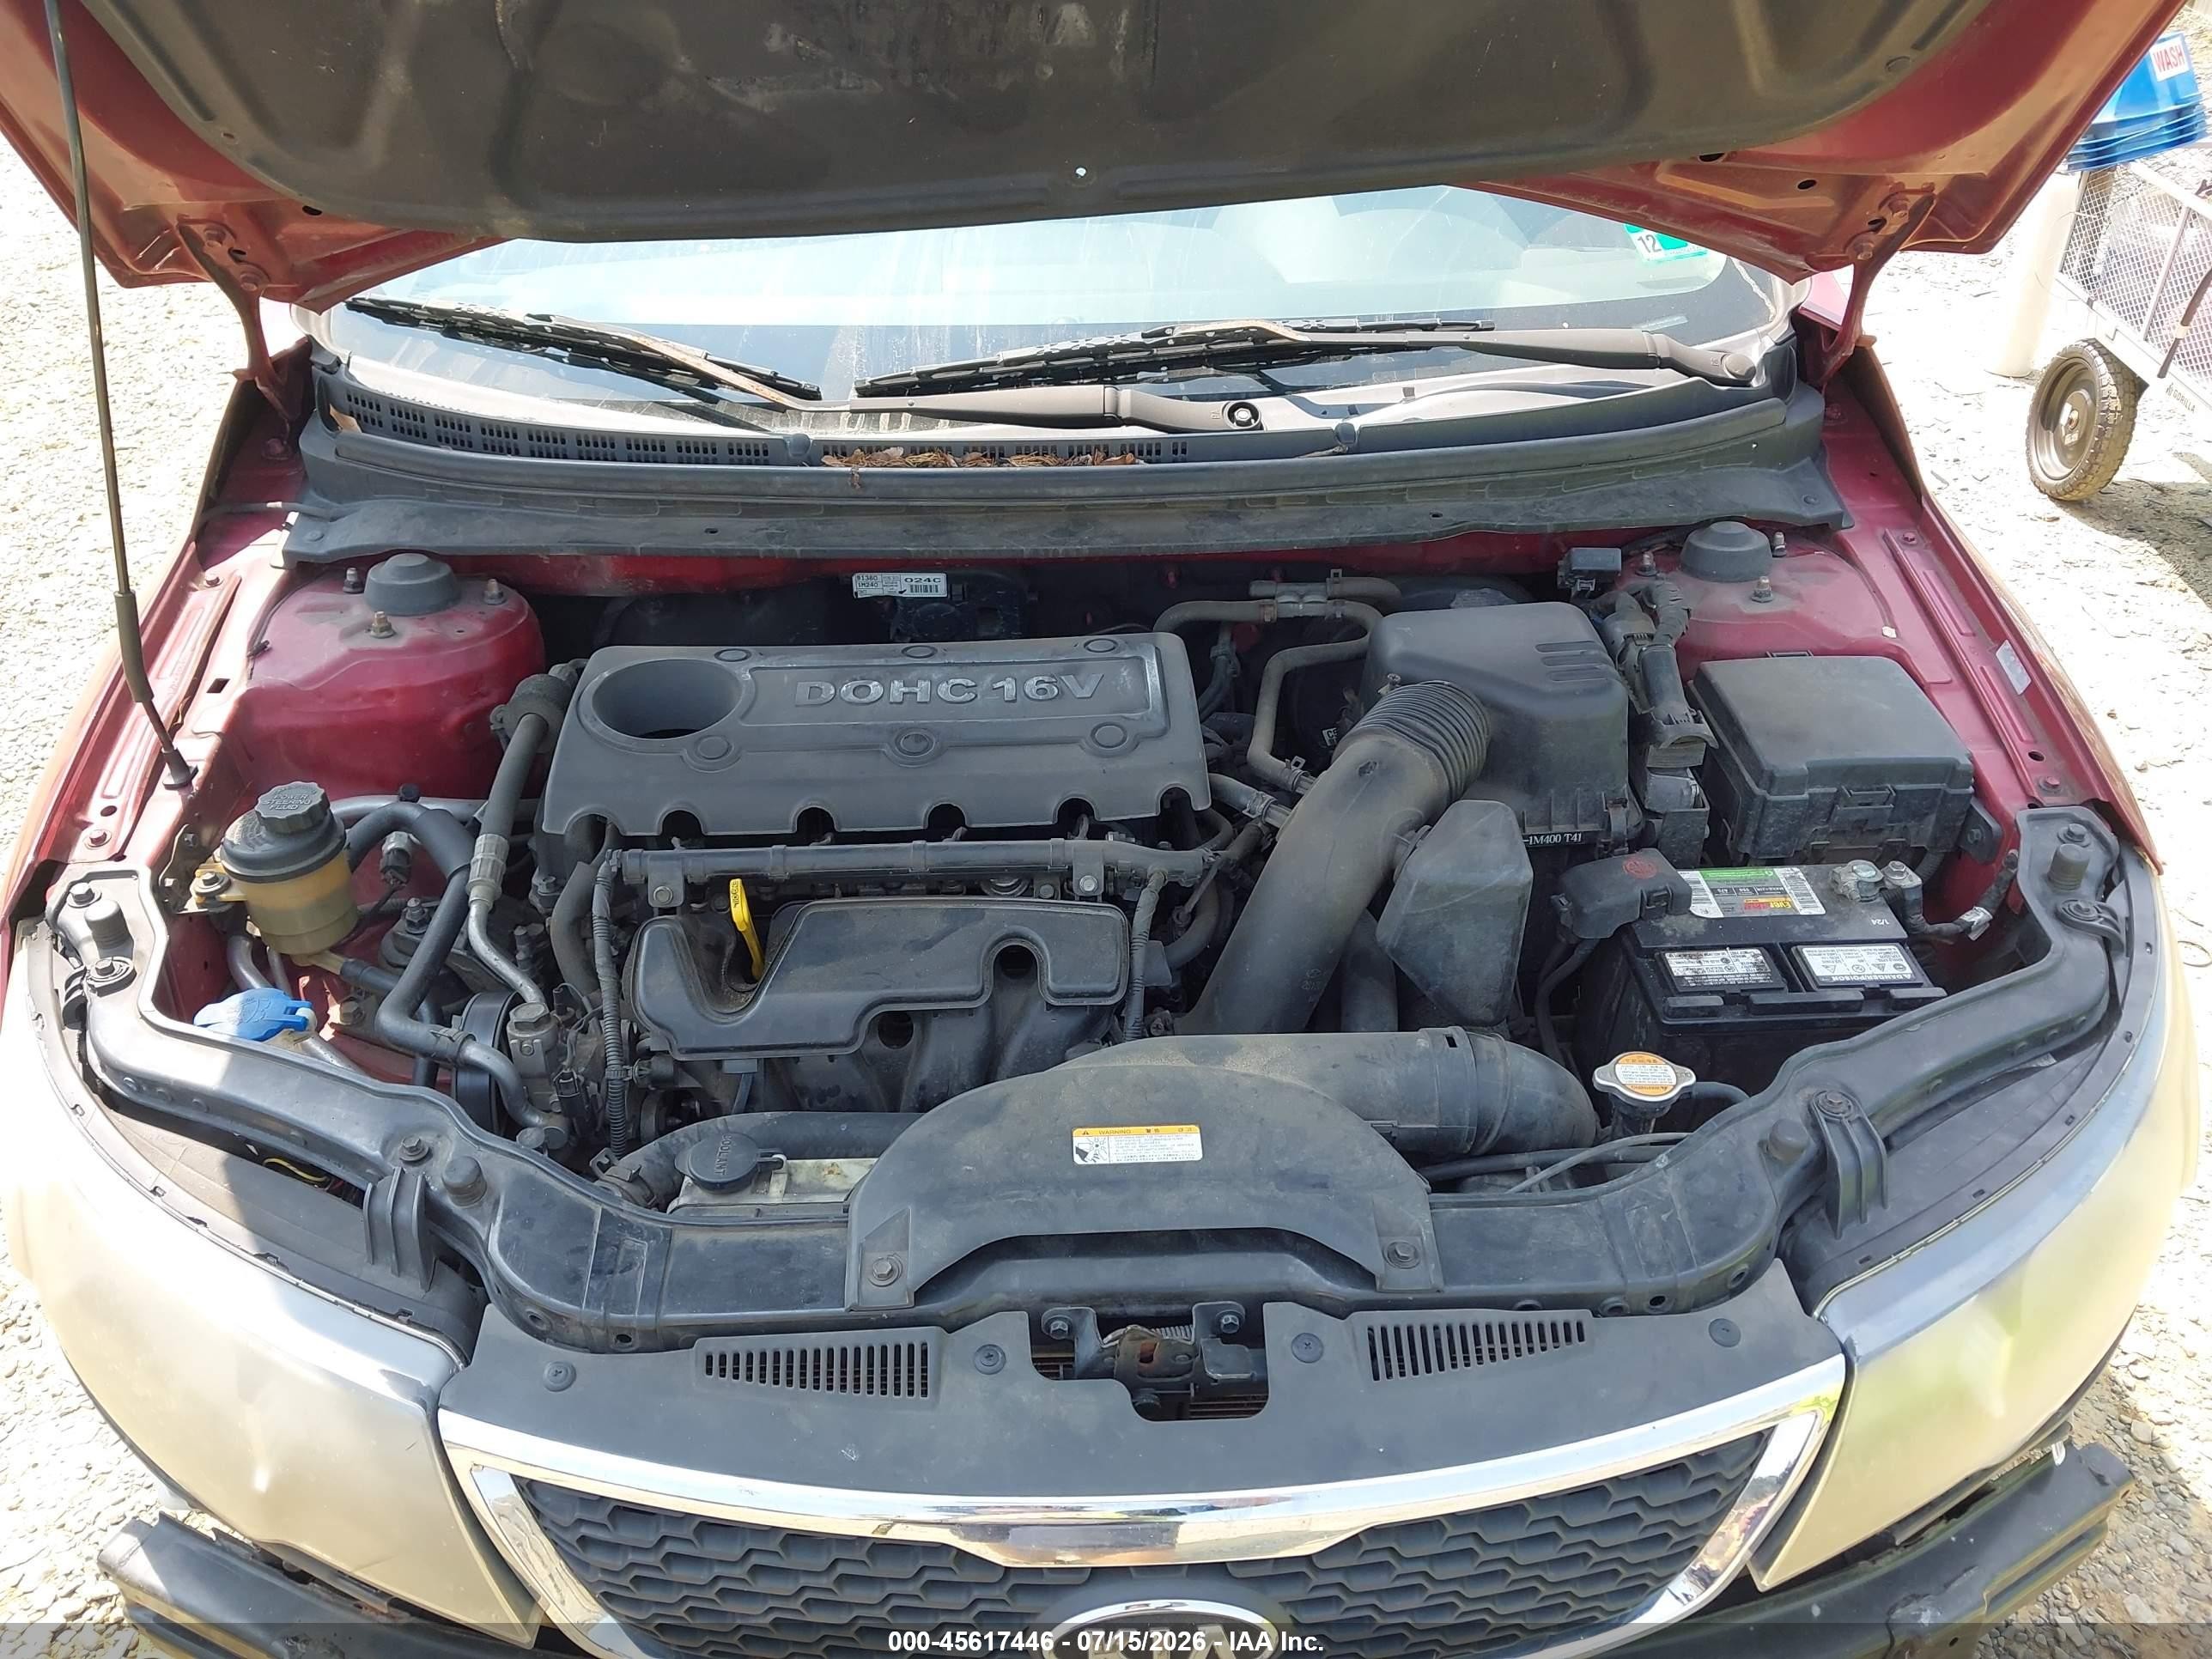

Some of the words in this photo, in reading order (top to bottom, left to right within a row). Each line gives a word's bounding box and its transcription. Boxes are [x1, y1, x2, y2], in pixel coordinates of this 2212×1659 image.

[2153, 45, 2186, 73] WASH
[1637, 234, 1662, 253] 12
[2172, 389, 2196, 413] GORILLA
[795, 678, 977, 706] DOHC
[992, 673, 1105, 703] 16V
[714, 1133, 732, 1176] COOLANT
